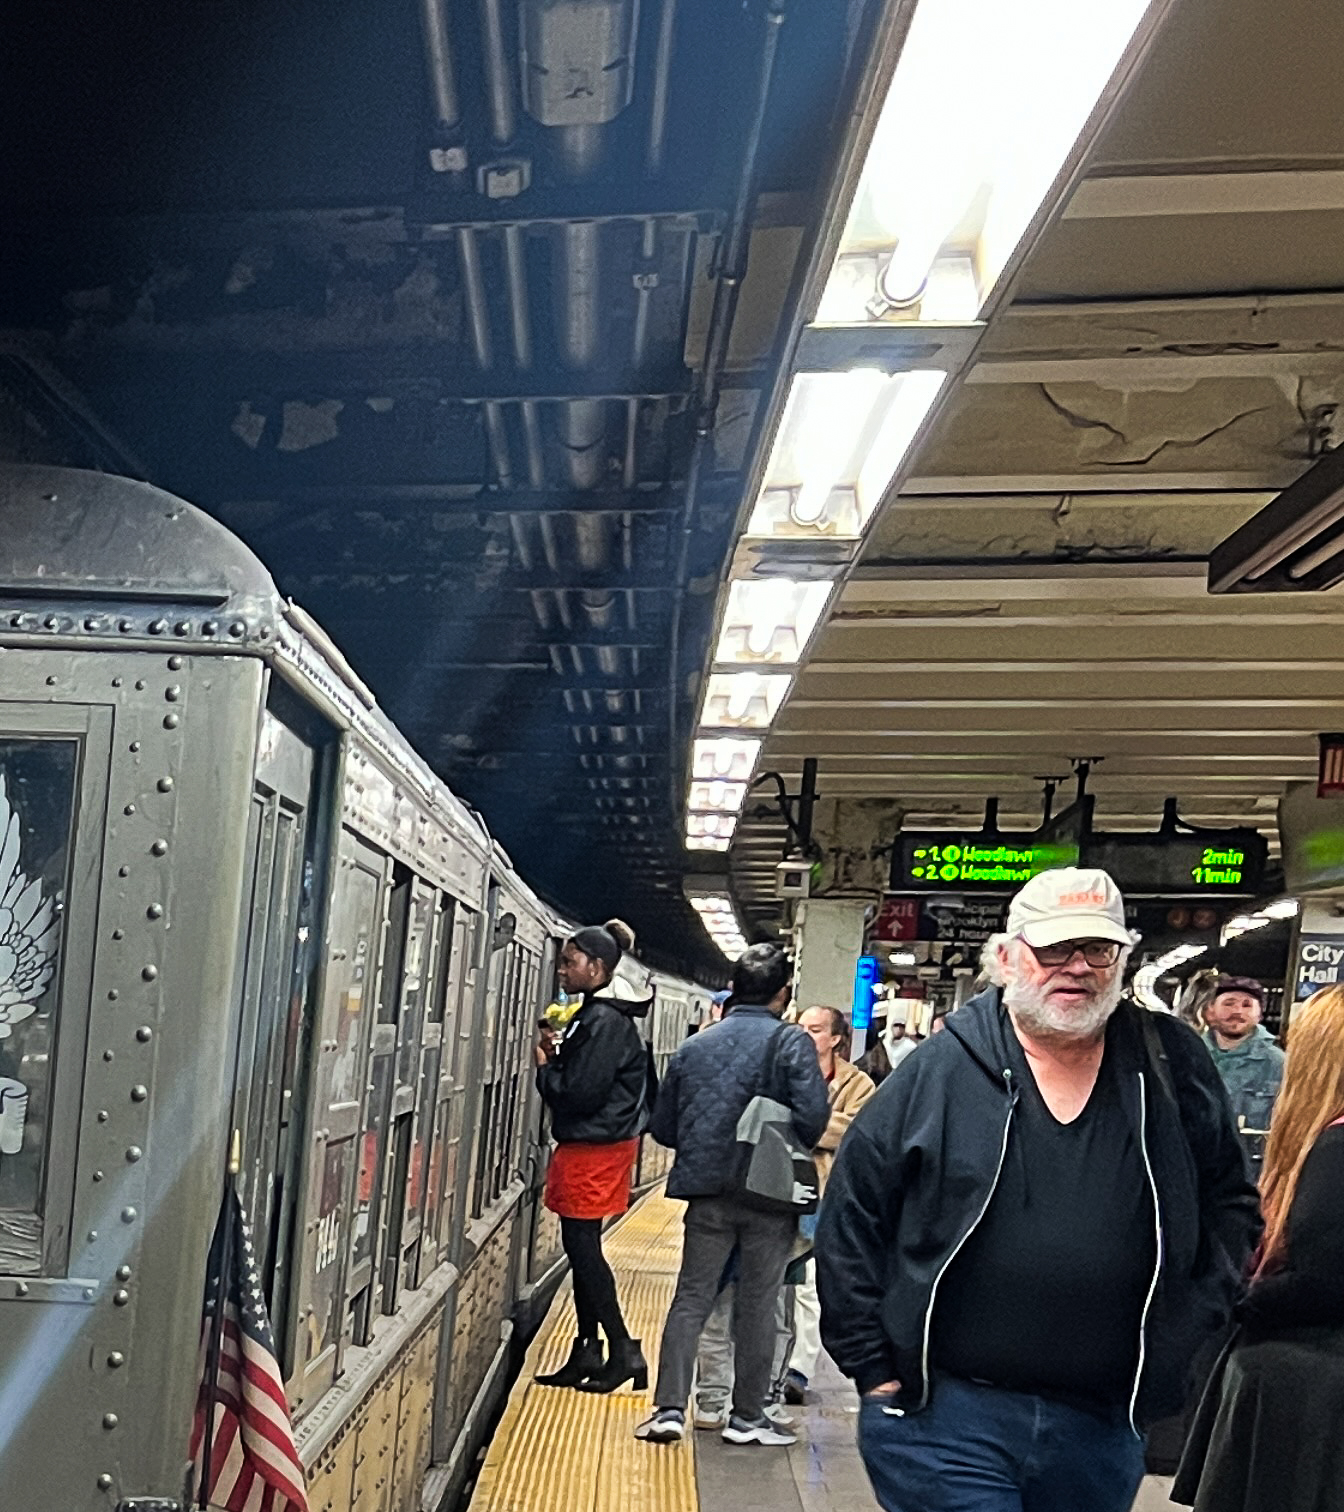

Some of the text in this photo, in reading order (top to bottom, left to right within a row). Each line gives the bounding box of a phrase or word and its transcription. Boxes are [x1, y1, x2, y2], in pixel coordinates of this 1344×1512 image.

[1202, 848, 1244, 865] 2min
[1191, 867, 1242, 884] 11min
[1301, 944, 1344, 965] City
[1299, 965, 1339, 984] Hall
